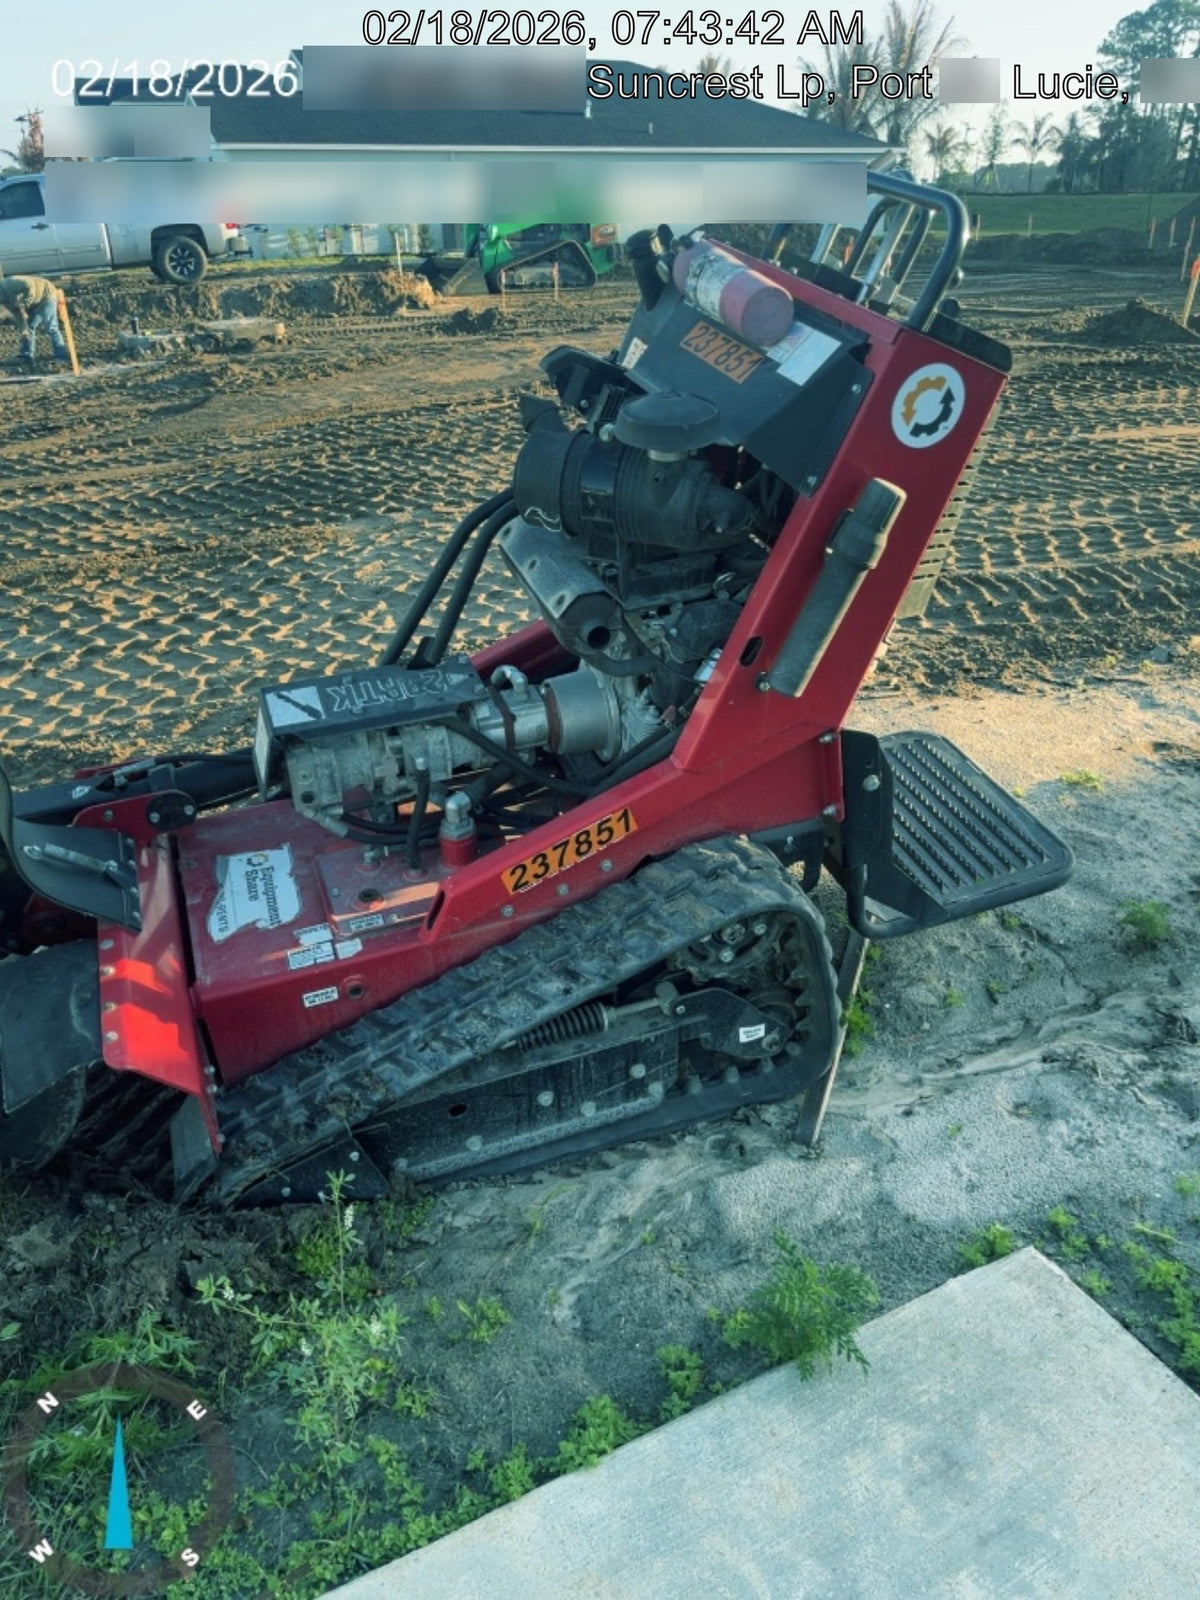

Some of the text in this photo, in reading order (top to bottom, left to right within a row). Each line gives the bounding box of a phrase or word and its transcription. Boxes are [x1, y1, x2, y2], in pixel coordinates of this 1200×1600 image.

[683, 324, 763, 380] 237851
[509, 807, 632, 892] 237851
[245, 868, 259, 902] Share
[260, 865, 281, 926] Equipment
